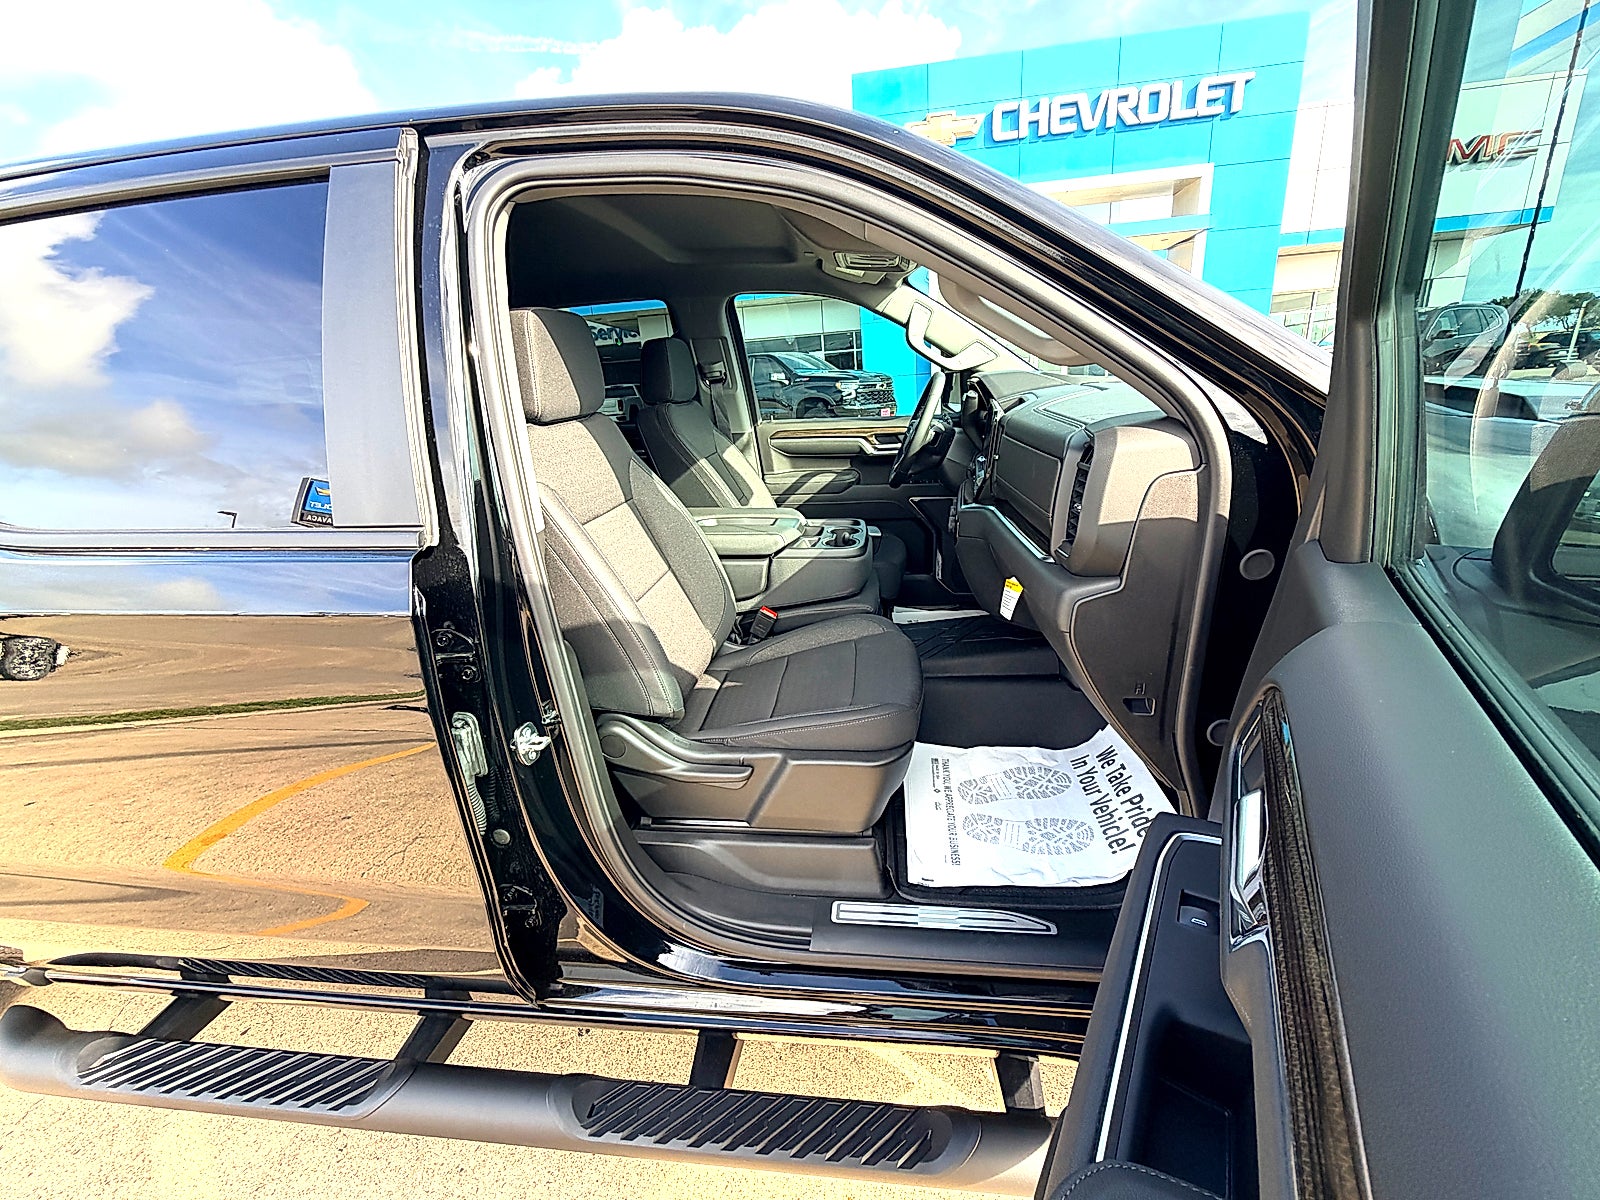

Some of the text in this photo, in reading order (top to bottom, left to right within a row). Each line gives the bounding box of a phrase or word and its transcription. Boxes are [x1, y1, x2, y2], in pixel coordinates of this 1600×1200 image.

[991, 71, 1256, 142] CHEVROLET
[1446, 129, 1543, 163] MC
[1070, 754, 1137, 855] In Your Vehicle!
[1095, 745, 1153, 838] We Take Pride
